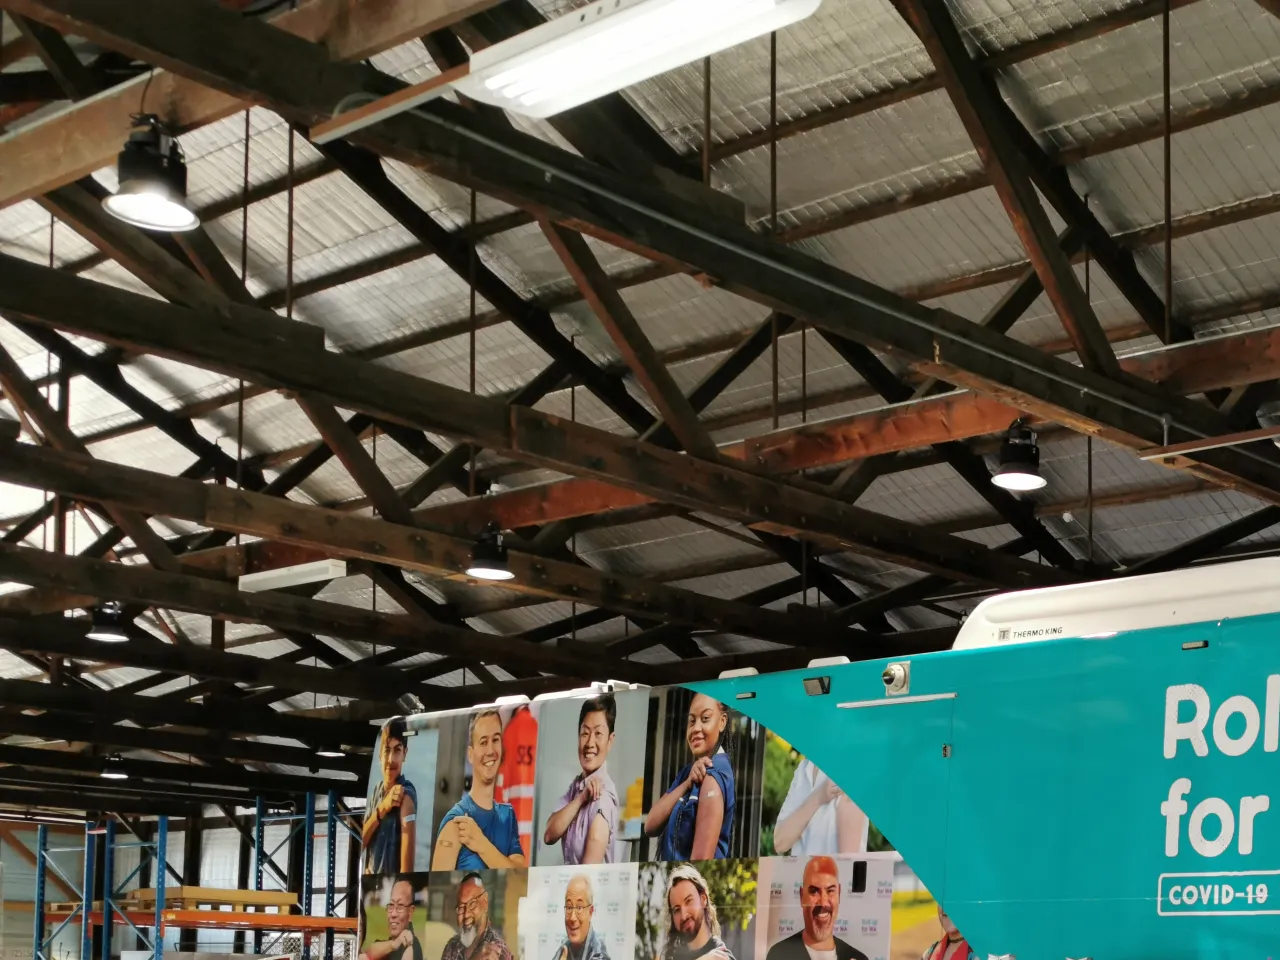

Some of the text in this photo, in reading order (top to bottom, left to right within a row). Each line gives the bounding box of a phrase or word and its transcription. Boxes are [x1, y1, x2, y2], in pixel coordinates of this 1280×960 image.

[1012, 628, 1044, 639] THERMO
[1044, 626, 1063, 636] KING
[1160, 777, 1270, 858] for
[1168, 883, 1269, 905] COVID-19
